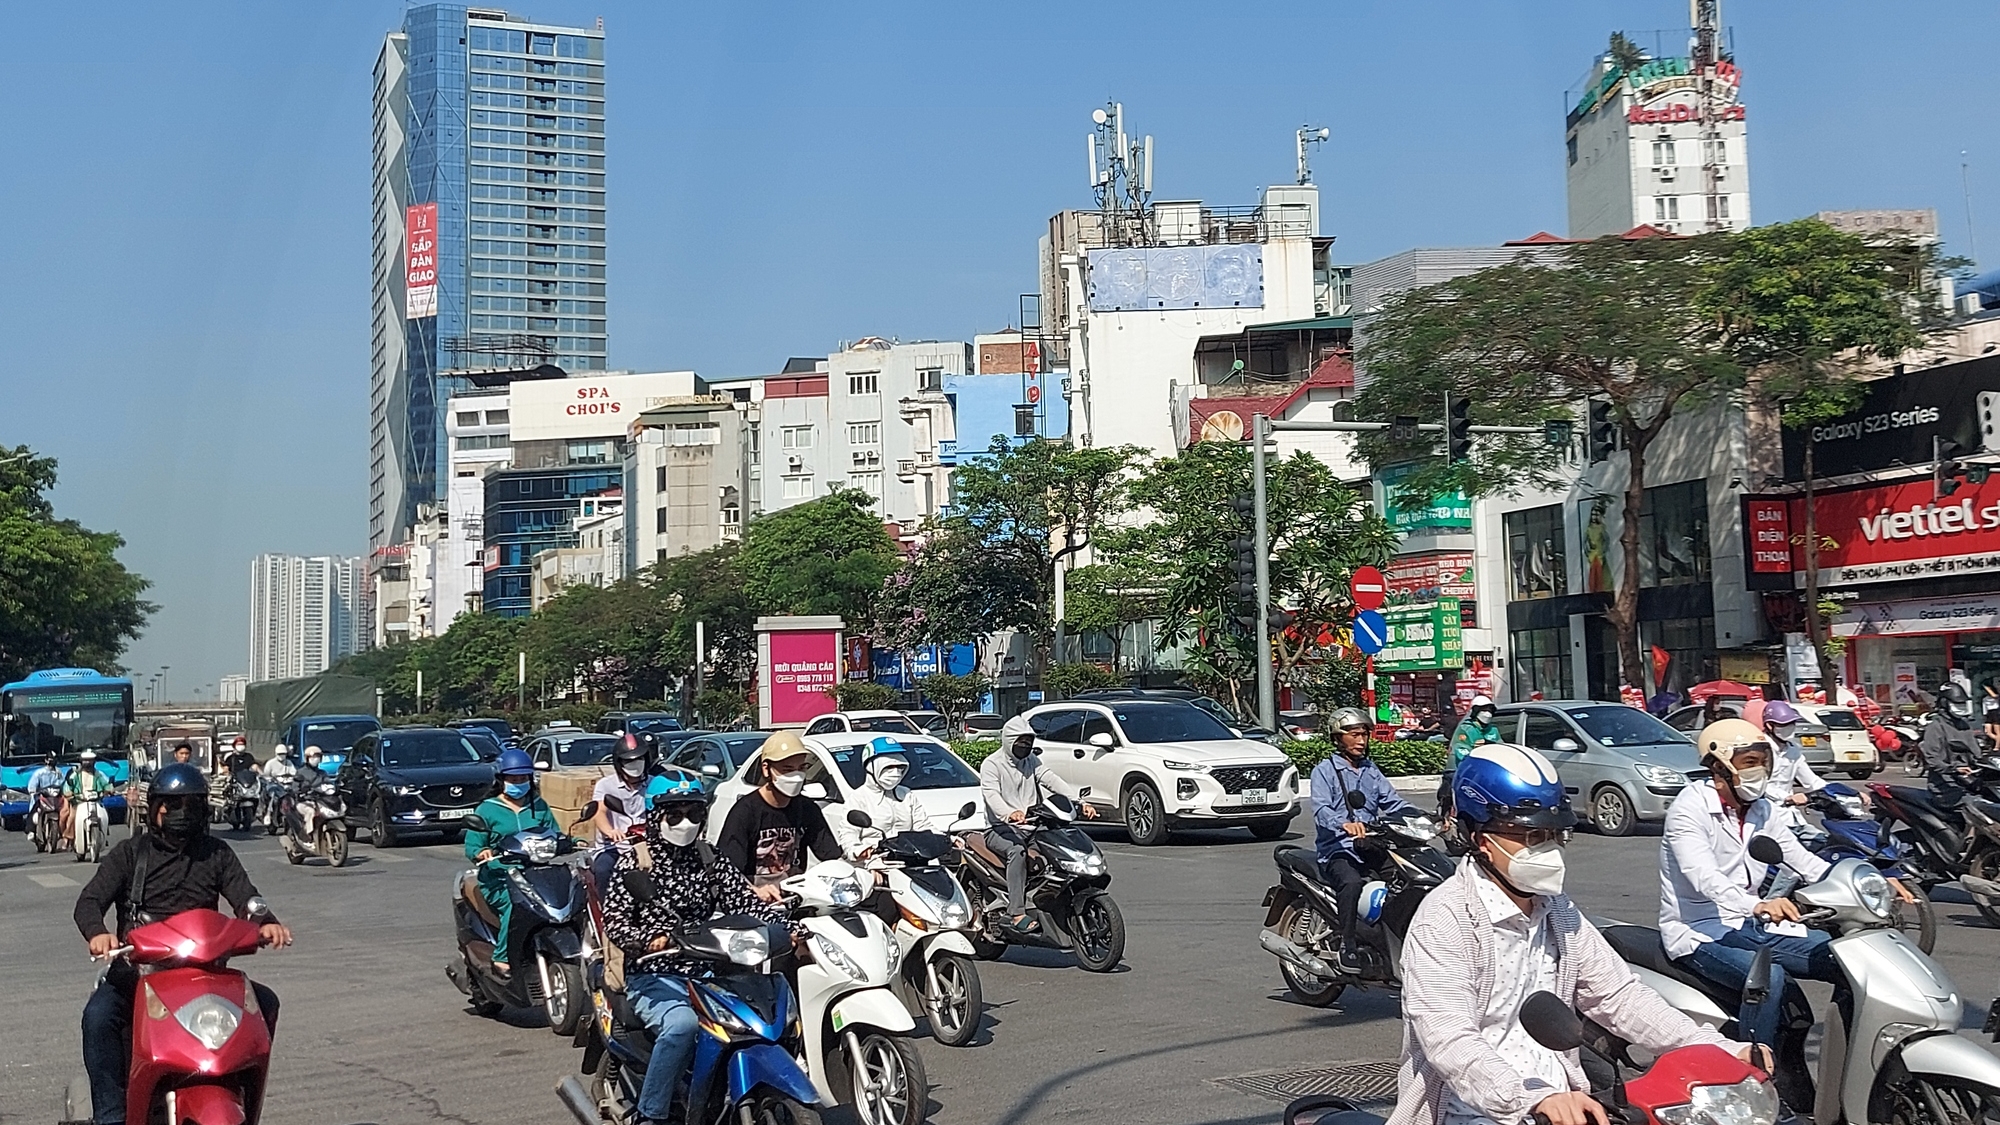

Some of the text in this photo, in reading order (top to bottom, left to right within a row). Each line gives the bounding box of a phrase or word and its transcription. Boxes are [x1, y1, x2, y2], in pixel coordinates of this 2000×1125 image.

[1629, 103, 1746, 124] RedDrz
[411, 236, 432, 253] SẮP
[411, 254, 433, 269] BÀN
[409, 273, 435, 283] GIAO
[577, 387, 610, 399] SPA
[566, 402, 621, 416] CHOI'S
[1812, 406, 1939, 442] Galaxy S23 Series
[1757, 507, 1782, 521] BÁN
[1858, 498, 2000, 540] viettel s
[1758, 528, 1784, 544] ĐIỆN
[1757, 551, 1789, 566] THOẠI
[1441, 586, 1475, 595] CHERRY
[1440, 600, 1458, 611] TRÁI
[1952, 608, 1967, 618] S23
[1969, 605, 1998, 616] Series
[1442, 613, 1458, 625] CÂY
[818, 660, 834, 671] CÁO
